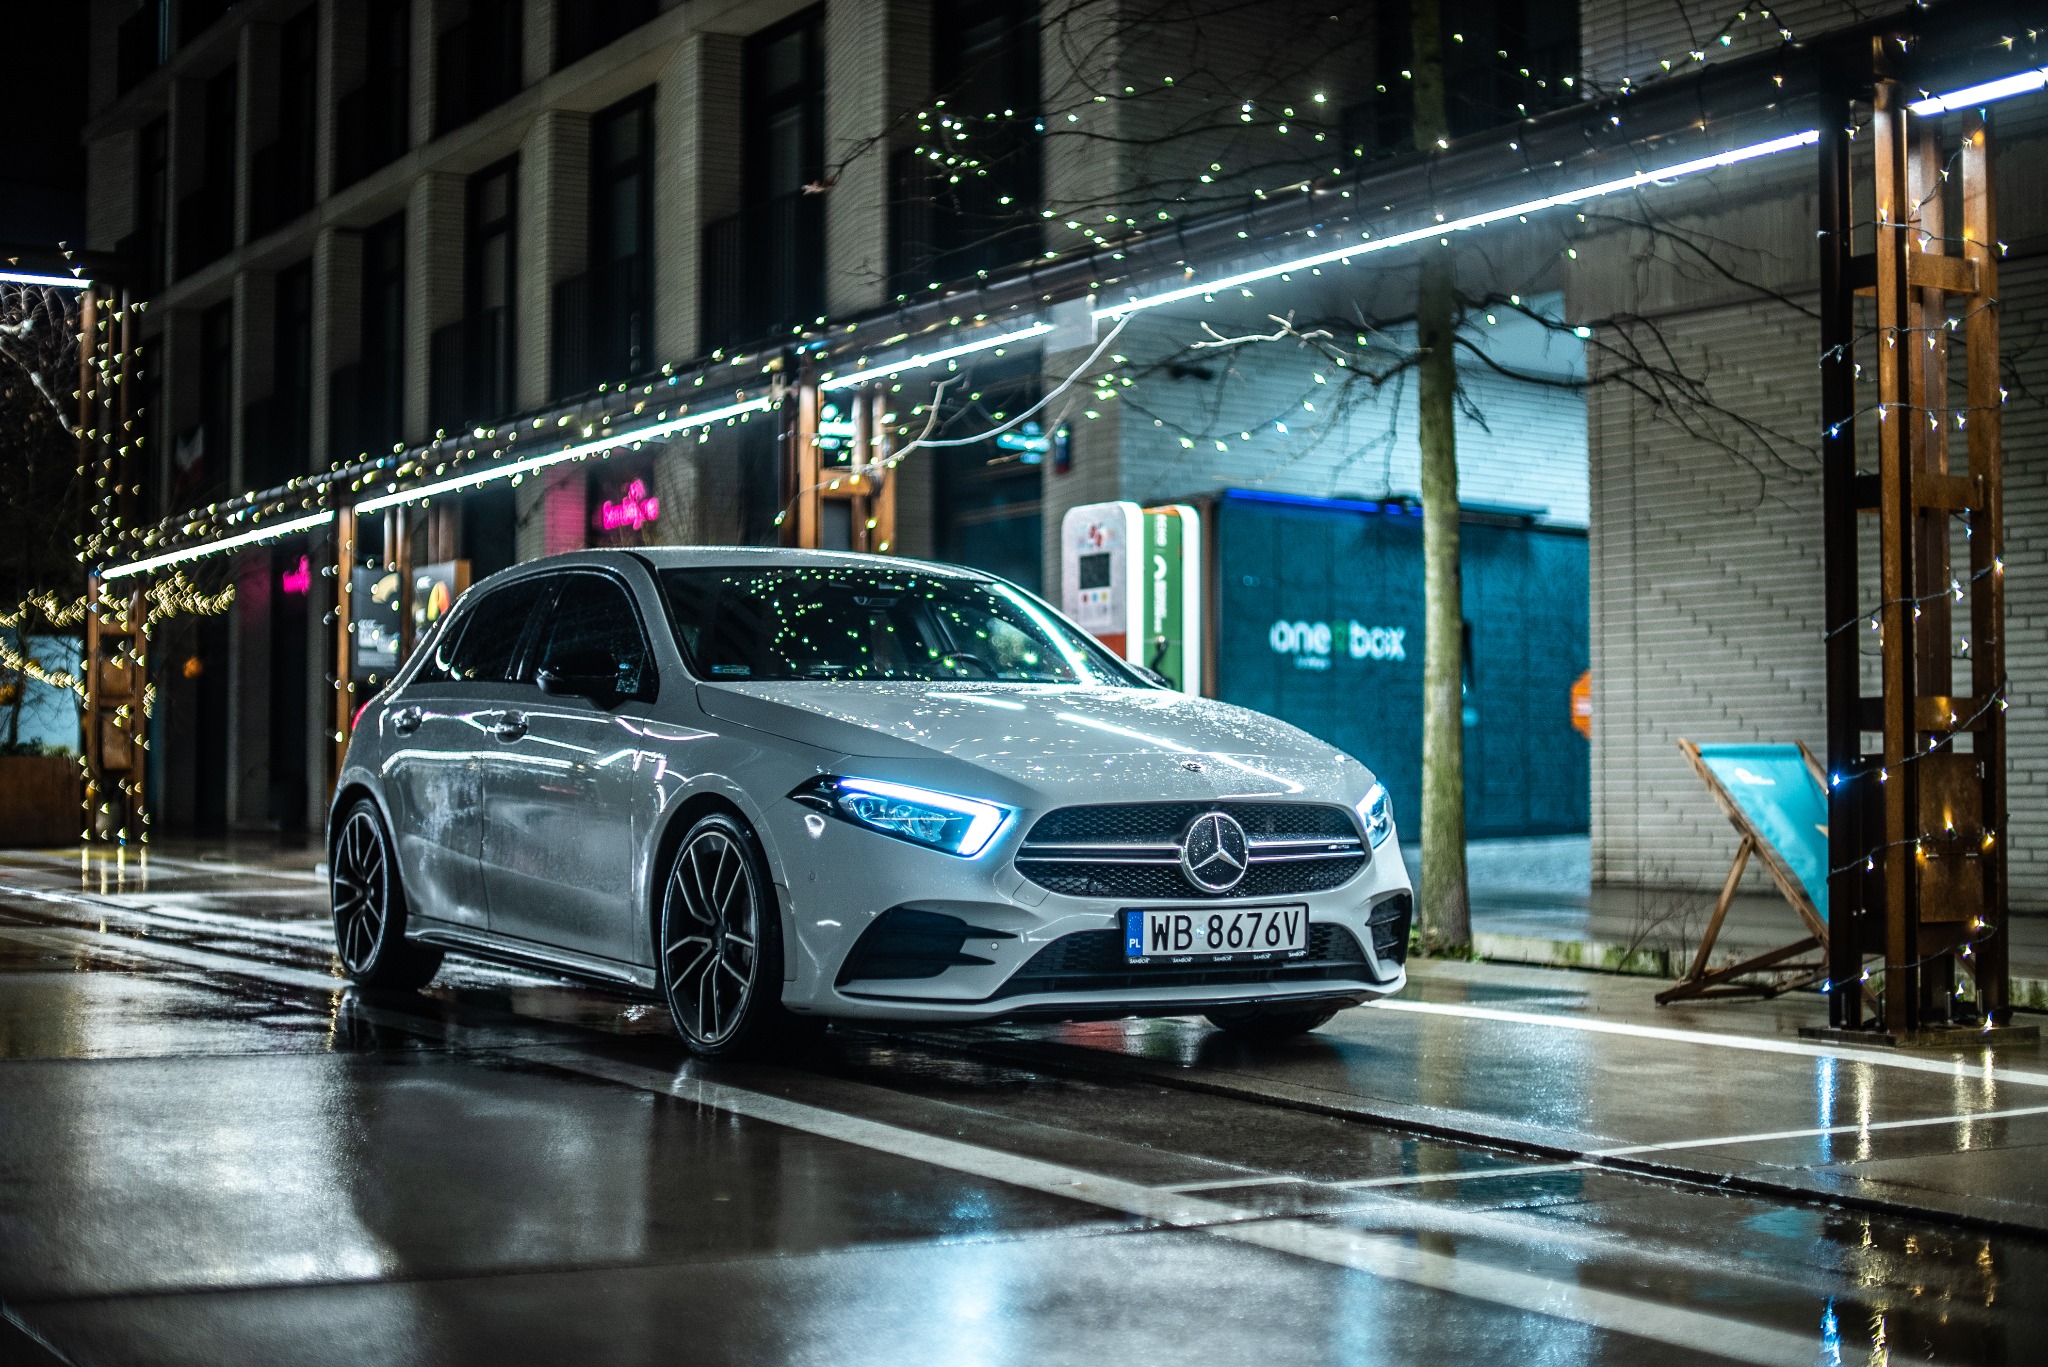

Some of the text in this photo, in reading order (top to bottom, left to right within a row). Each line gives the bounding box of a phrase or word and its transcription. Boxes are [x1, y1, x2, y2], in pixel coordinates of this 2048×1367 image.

[1349, 618, 1406, 661] box
[1129, 938, 1141, 949] PL
[1151, 911, 1299, 951] WB 8676V
